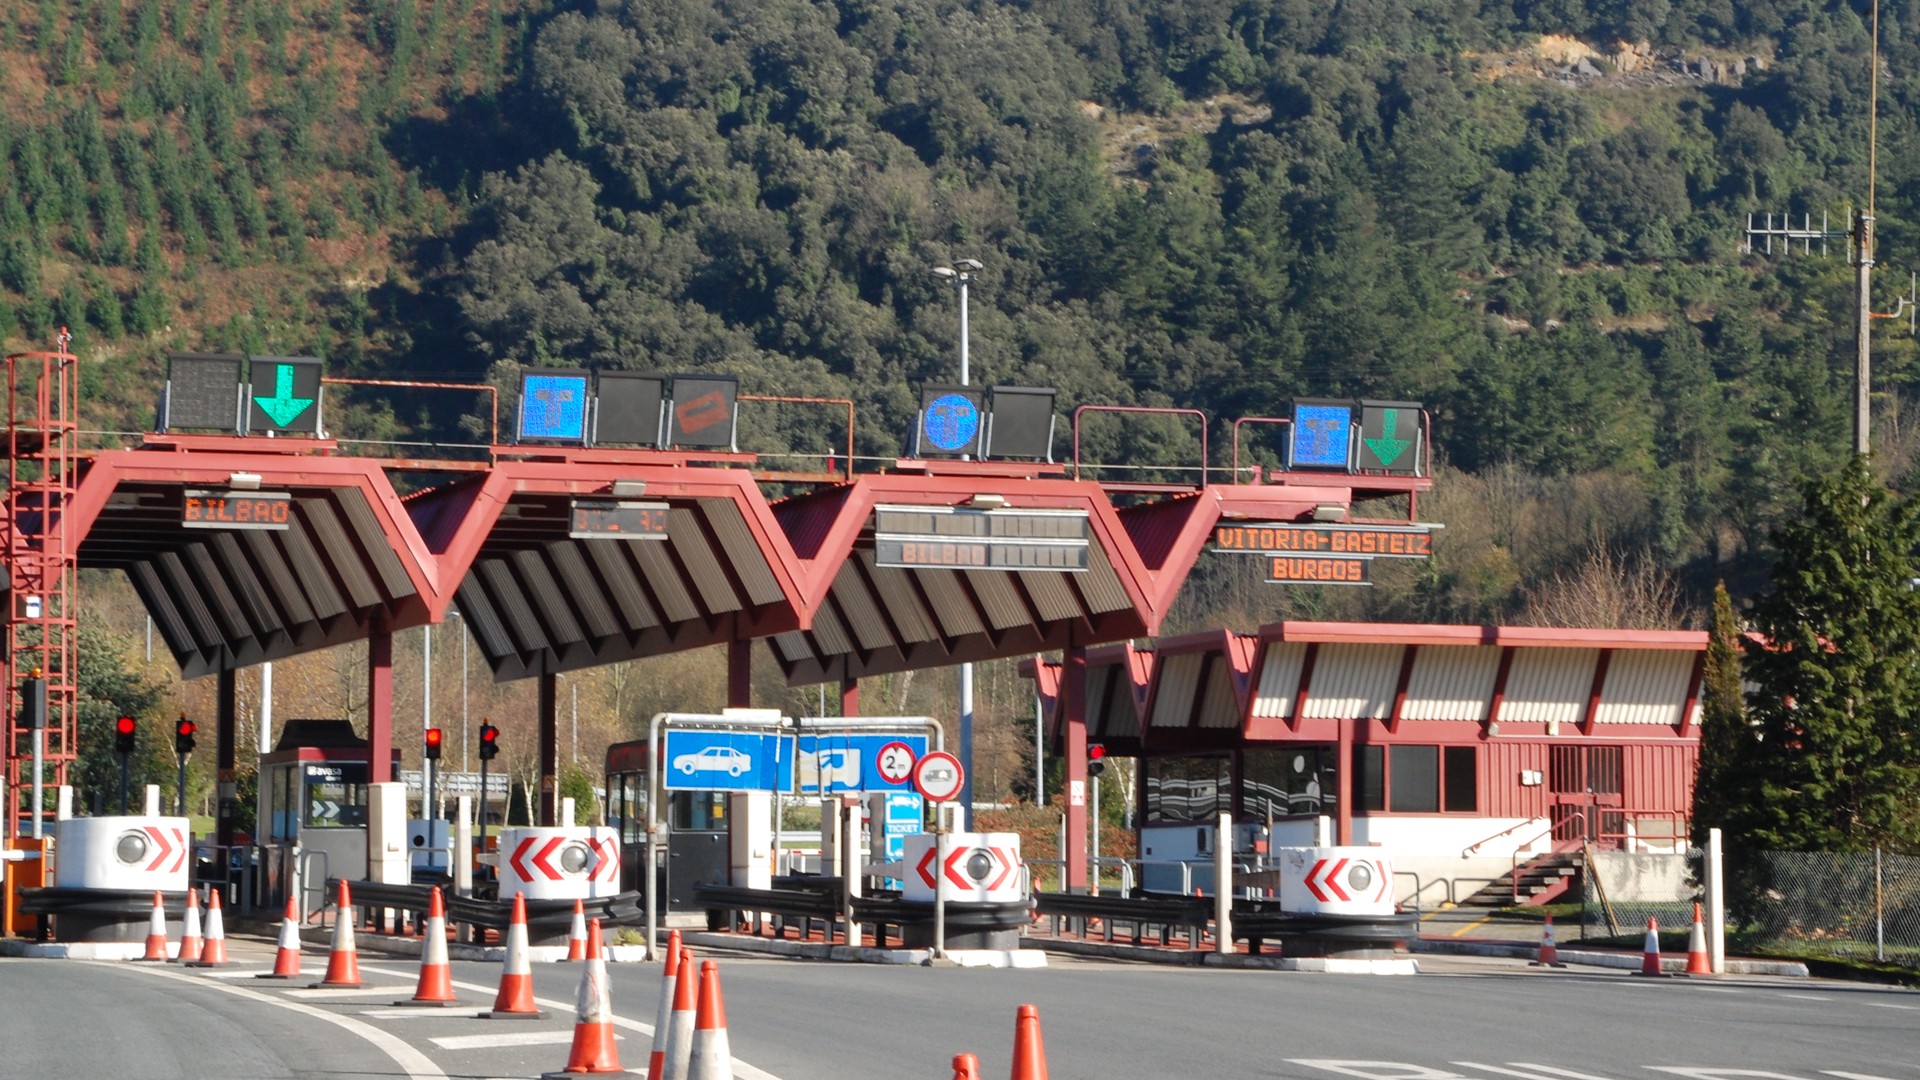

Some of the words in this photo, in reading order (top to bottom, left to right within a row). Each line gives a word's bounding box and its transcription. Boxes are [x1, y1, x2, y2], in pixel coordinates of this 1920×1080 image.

[185, 498, 289, 522] BILBAO
[1217, 527, 1432, 555] VITORIA-GASTEIZ
[1273, 558, 1362, 581] BURGOS
[886, 755, 895, 769] 2
[887, 824, 919, 833] TICKET
